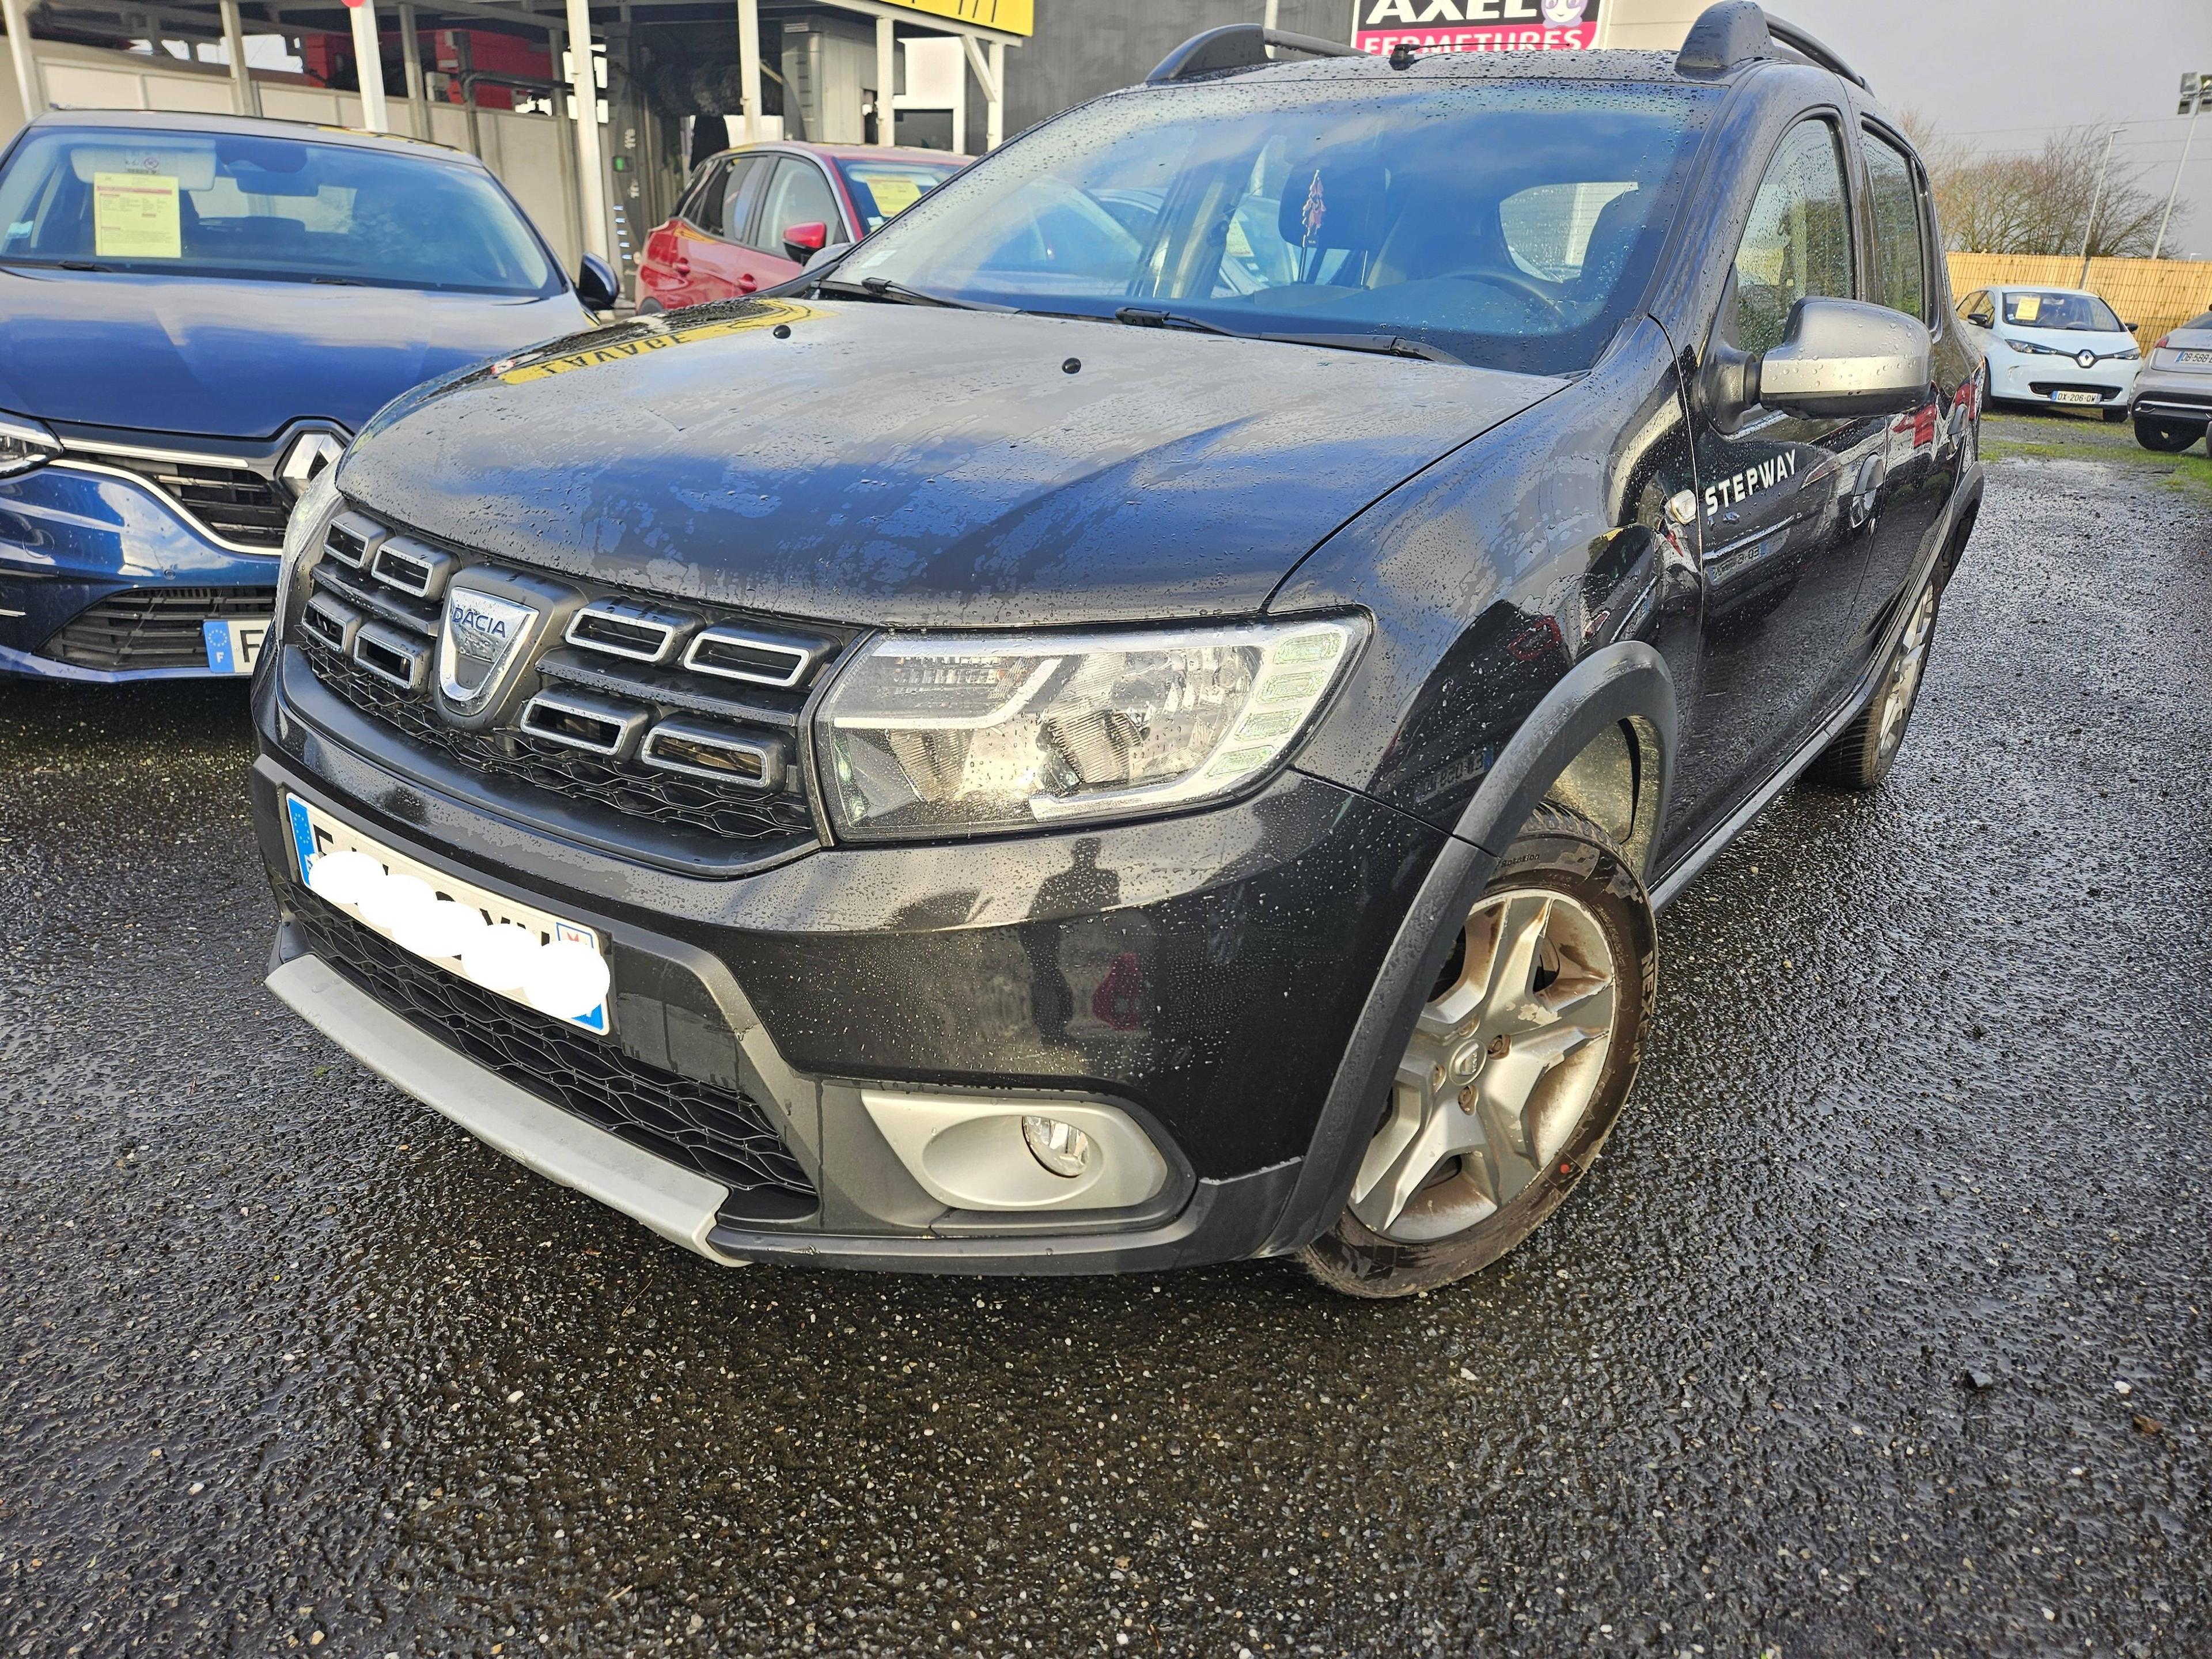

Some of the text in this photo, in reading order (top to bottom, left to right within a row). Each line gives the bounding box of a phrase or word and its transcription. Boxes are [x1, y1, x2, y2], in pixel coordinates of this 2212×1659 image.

[1705, 449, 1796, 517] STEPWAY
[452, 607, 505, 638] DACIA
[216, 652, 224, 663] F
[1630, 950, 1654, 1064] NEXEN
